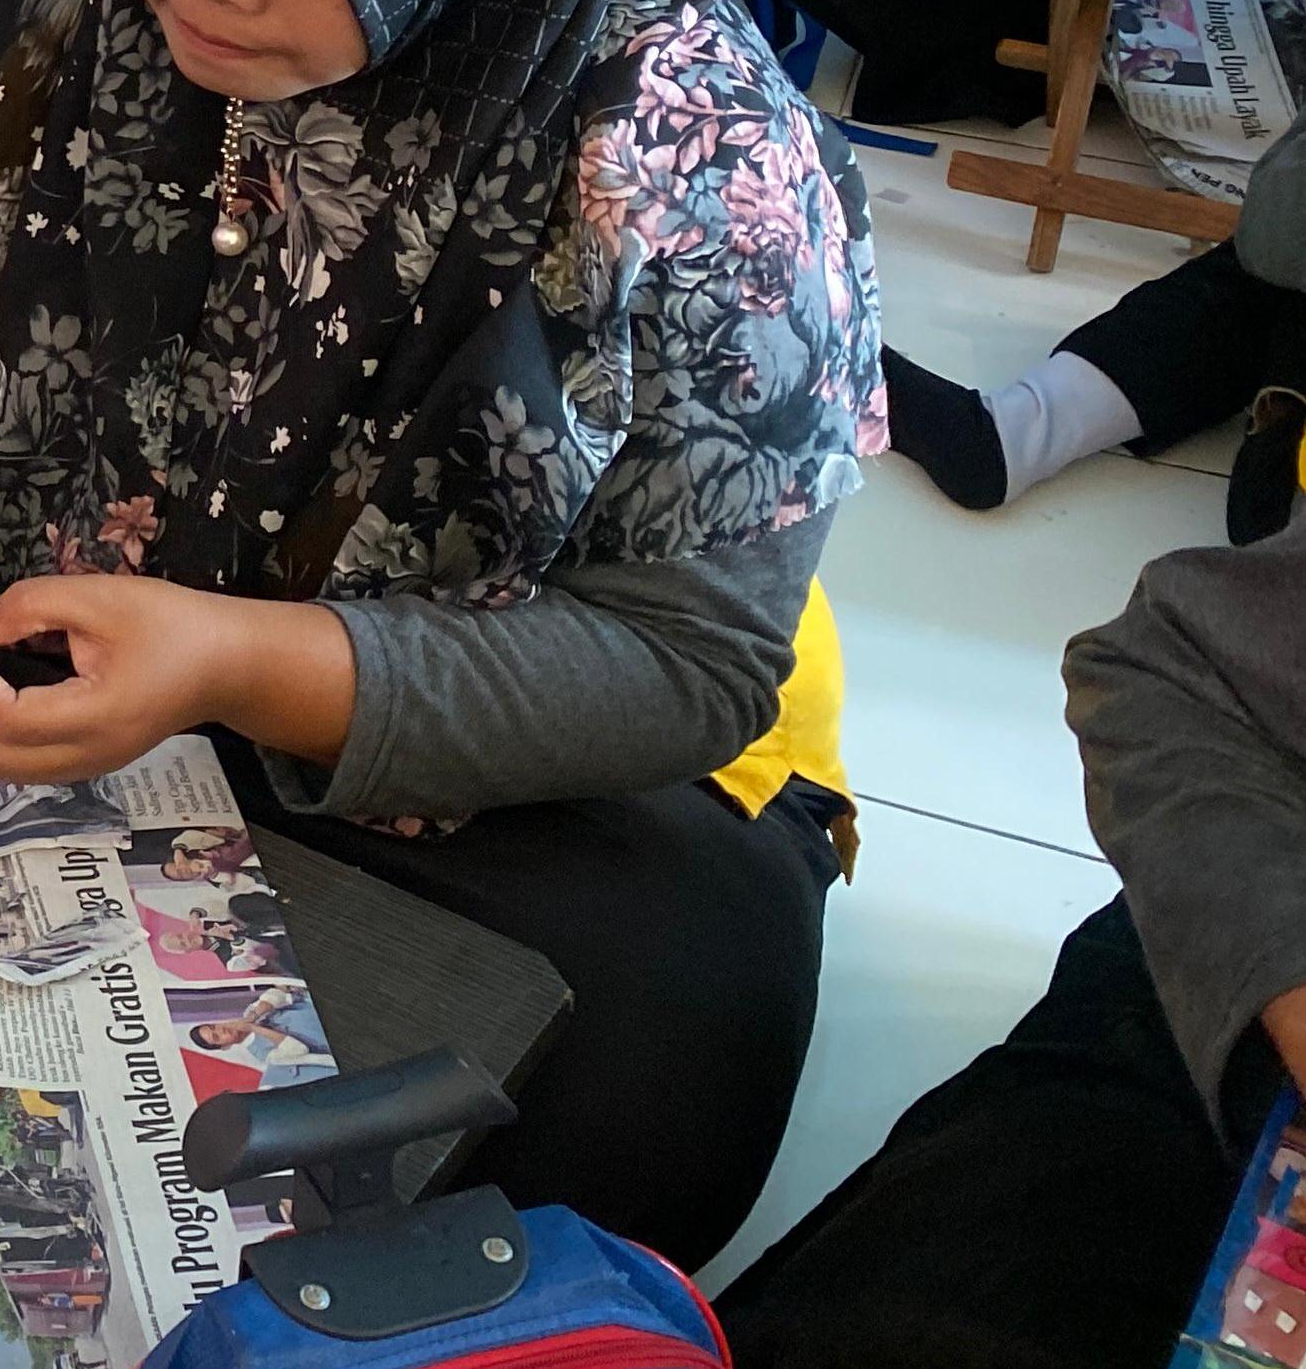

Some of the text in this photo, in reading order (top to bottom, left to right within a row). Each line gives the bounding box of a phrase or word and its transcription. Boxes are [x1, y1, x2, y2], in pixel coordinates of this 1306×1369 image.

[1205, 0, 1235, 58] hingga
[1215, 55, 1256, 98] Upah
[1229, 96, 1271, 139] Layak
[58, 851, 127, 919] ga Up
[90, 962, 151, 1046] Gratis
[124, 1050, 181, 1145] Makan
[153, 1147, 220, 1278] Program
